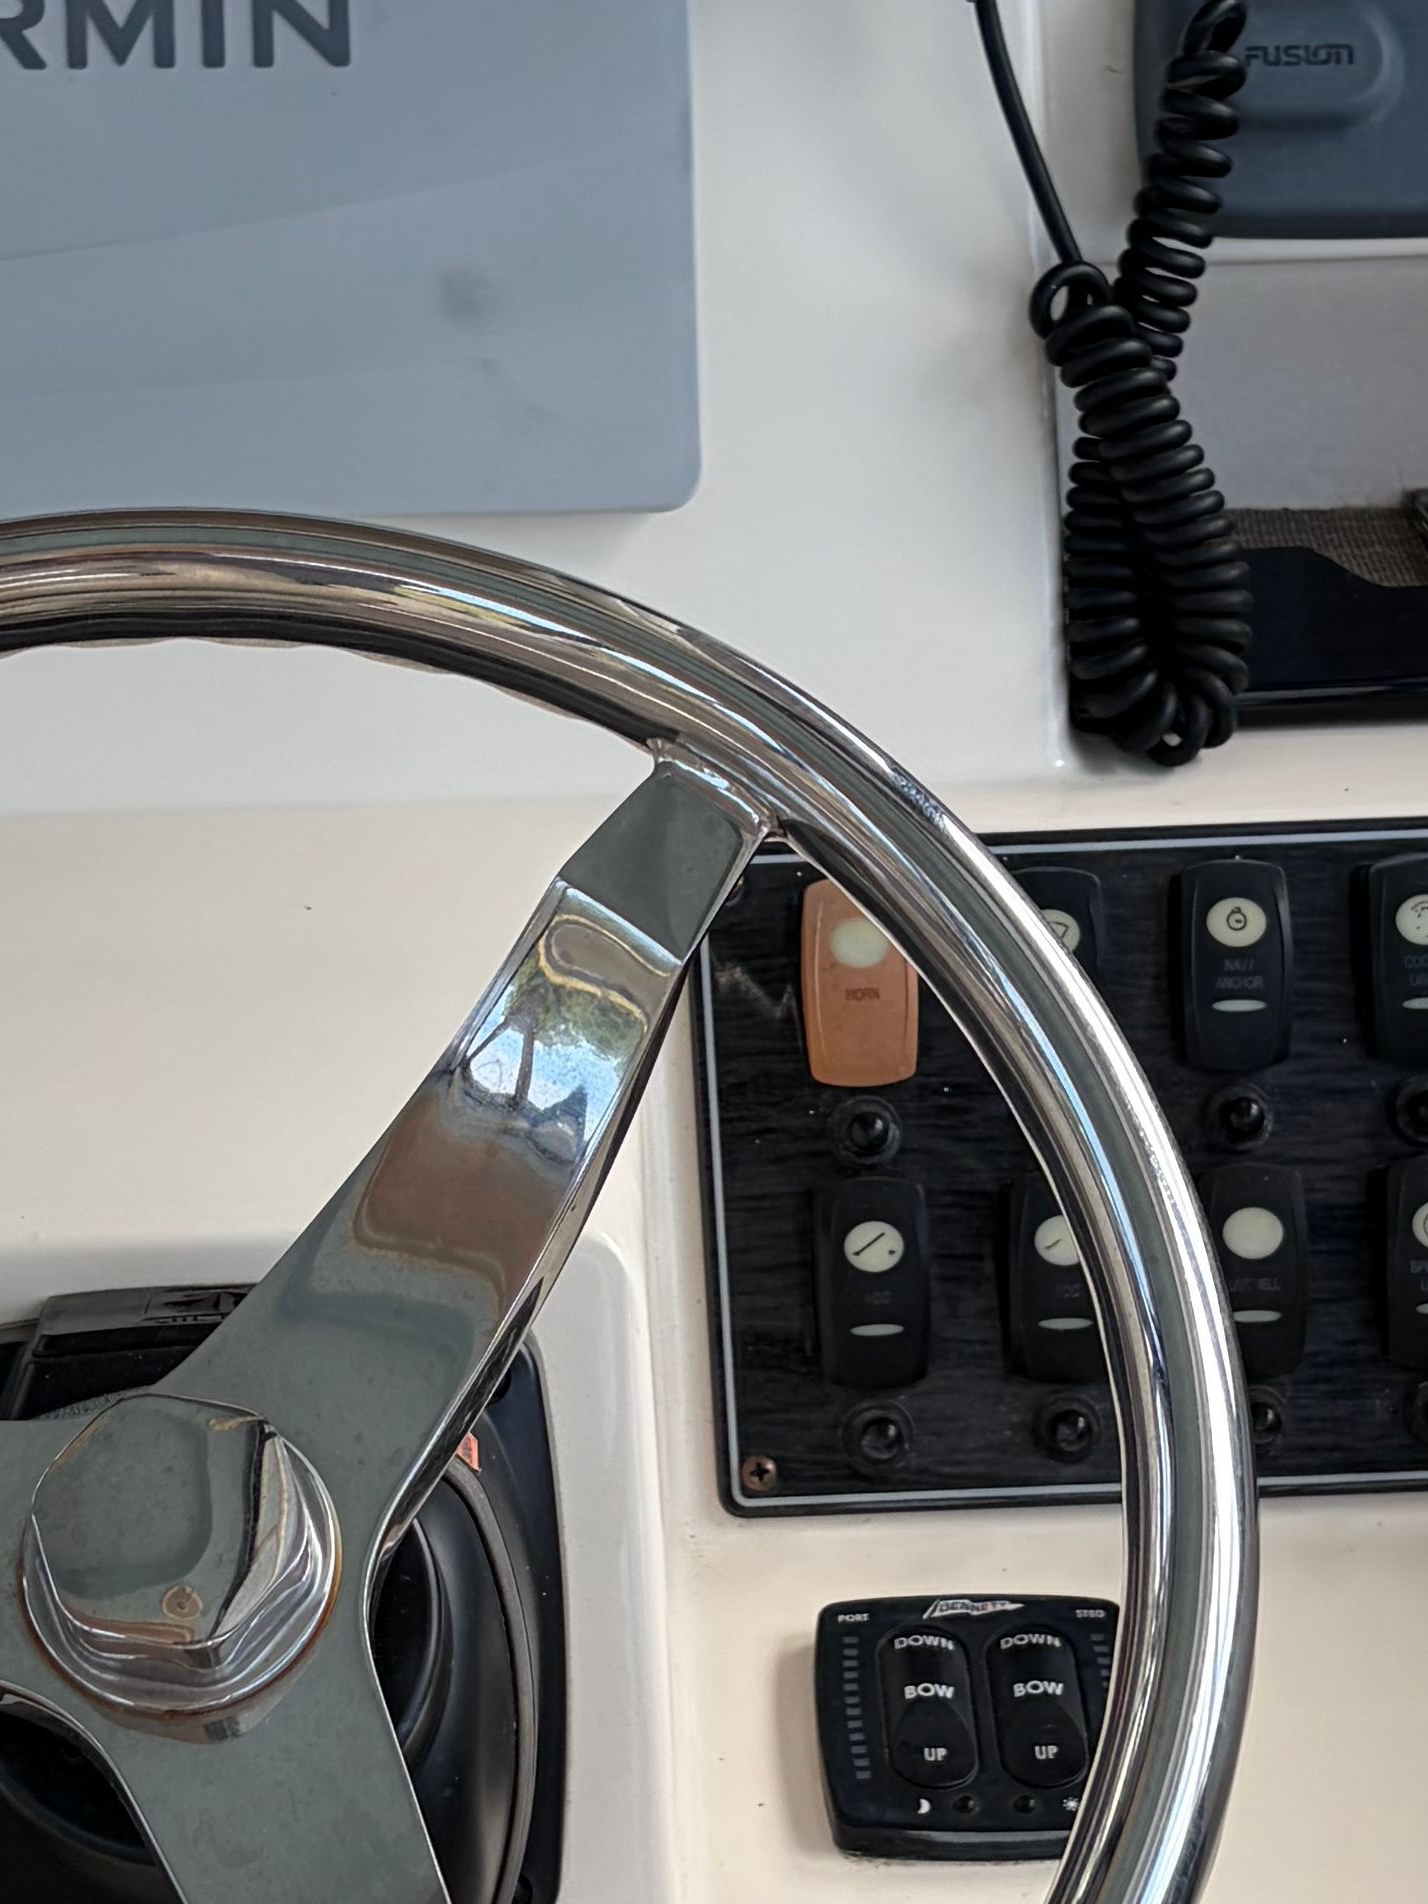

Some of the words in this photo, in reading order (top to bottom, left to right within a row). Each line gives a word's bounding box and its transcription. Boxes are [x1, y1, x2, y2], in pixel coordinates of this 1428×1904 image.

[1244, 43, 1355, 68] FUSION
[845, 986, 880, 1001] HORN
[837, 1612, 870, 1623] PORT
[1075, 1608, 1106, 1618] STBD
[894, 1634, 955, 1651] DOWN
[1000, 1633, 1062, 1650] DOWN
[904, 1682, 956, 1699] BOW
[1012, 1680, 1064, 1696] BOW
[923, 1747, 949, 1762] UP
[1034, 1745, 1059, 1760] UP
